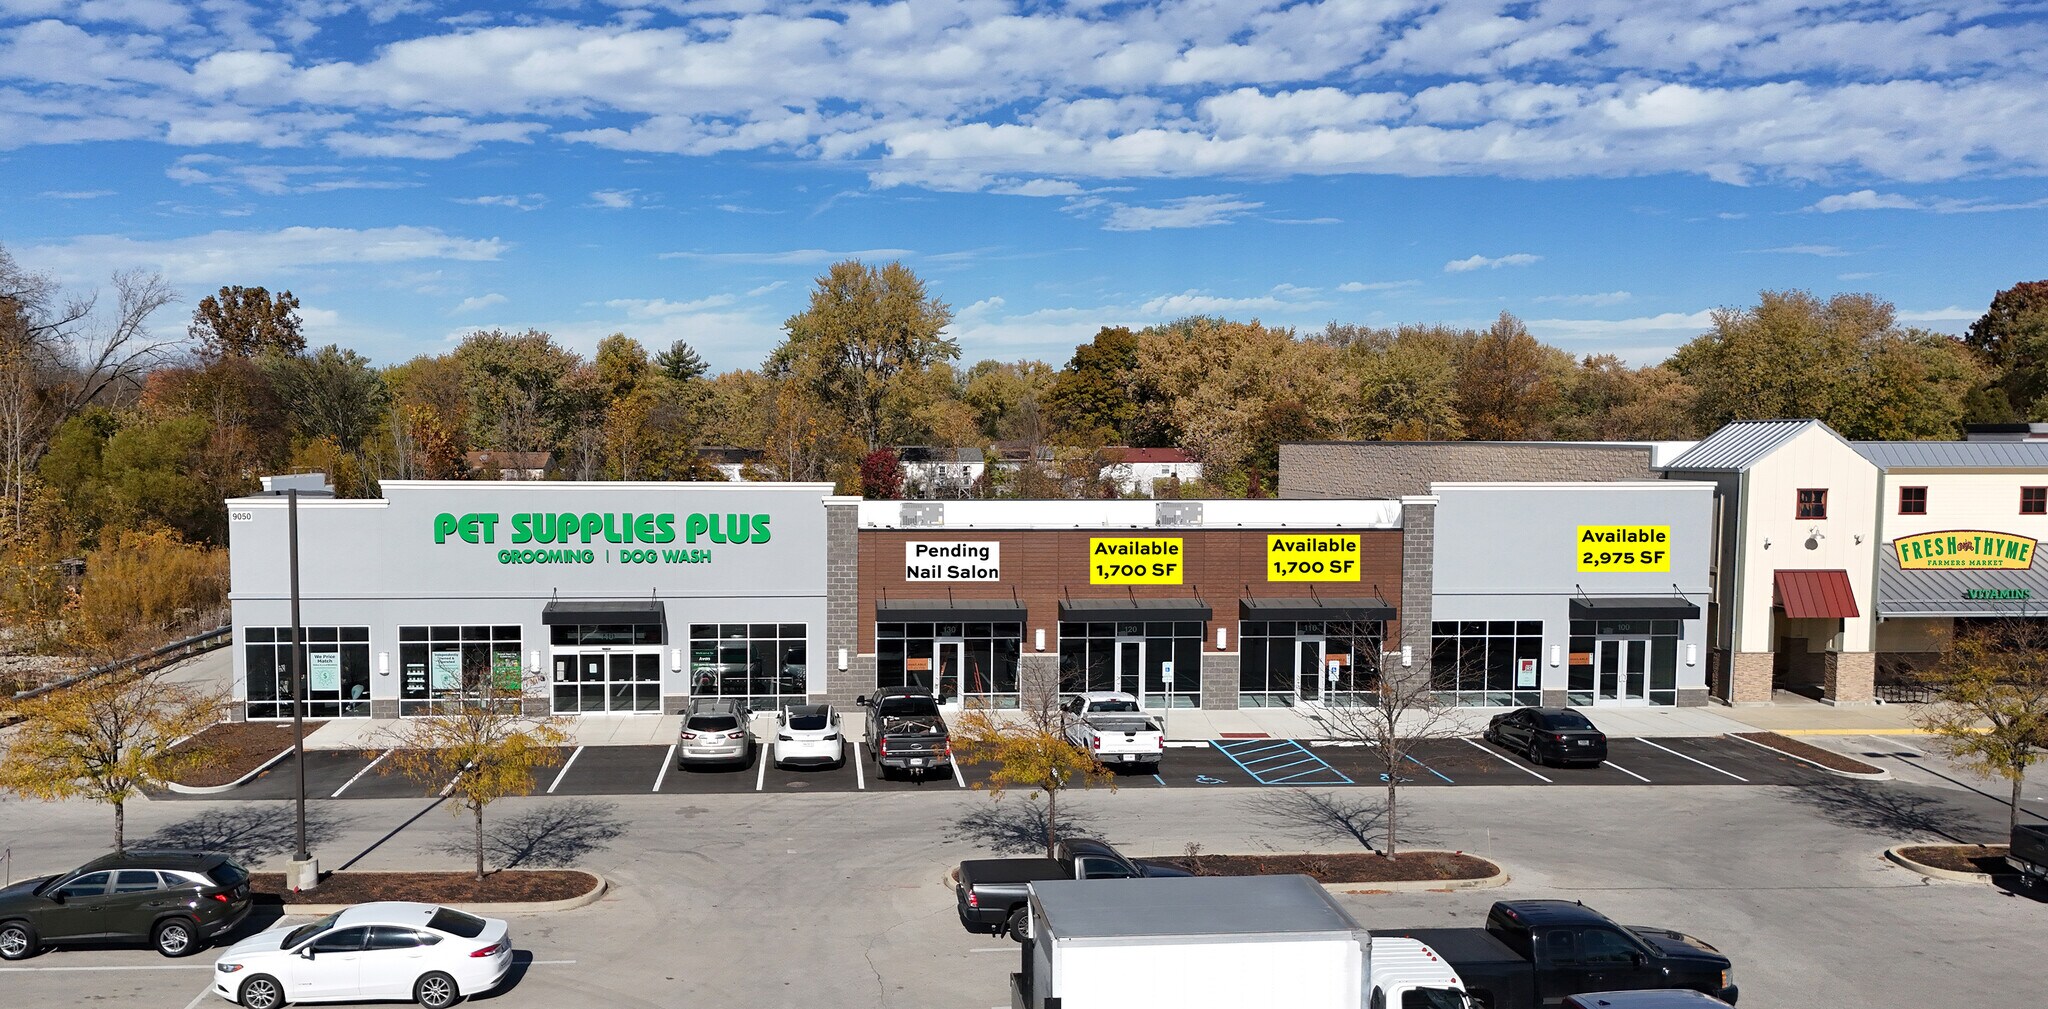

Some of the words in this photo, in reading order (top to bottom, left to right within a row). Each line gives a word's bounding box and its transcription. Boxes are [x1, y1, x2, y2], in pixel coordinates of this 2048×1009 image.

[232, 512, 252, 521] 9050
[433, 512, 499, 544] PET
[511, 512, 676, 544] SUPPLIES
[685, 512, 772, 544] PLUS
[497, 549, 594, 564] GROOMING
[620, 549, 657, 564] DOG
[664, 549, 712, 564] WASH
[1901, 536, 1957, 562] FRESH
[1974, 536, 2030, 562] THYME
[1967, 588, 2032, 600] VITAMINS
